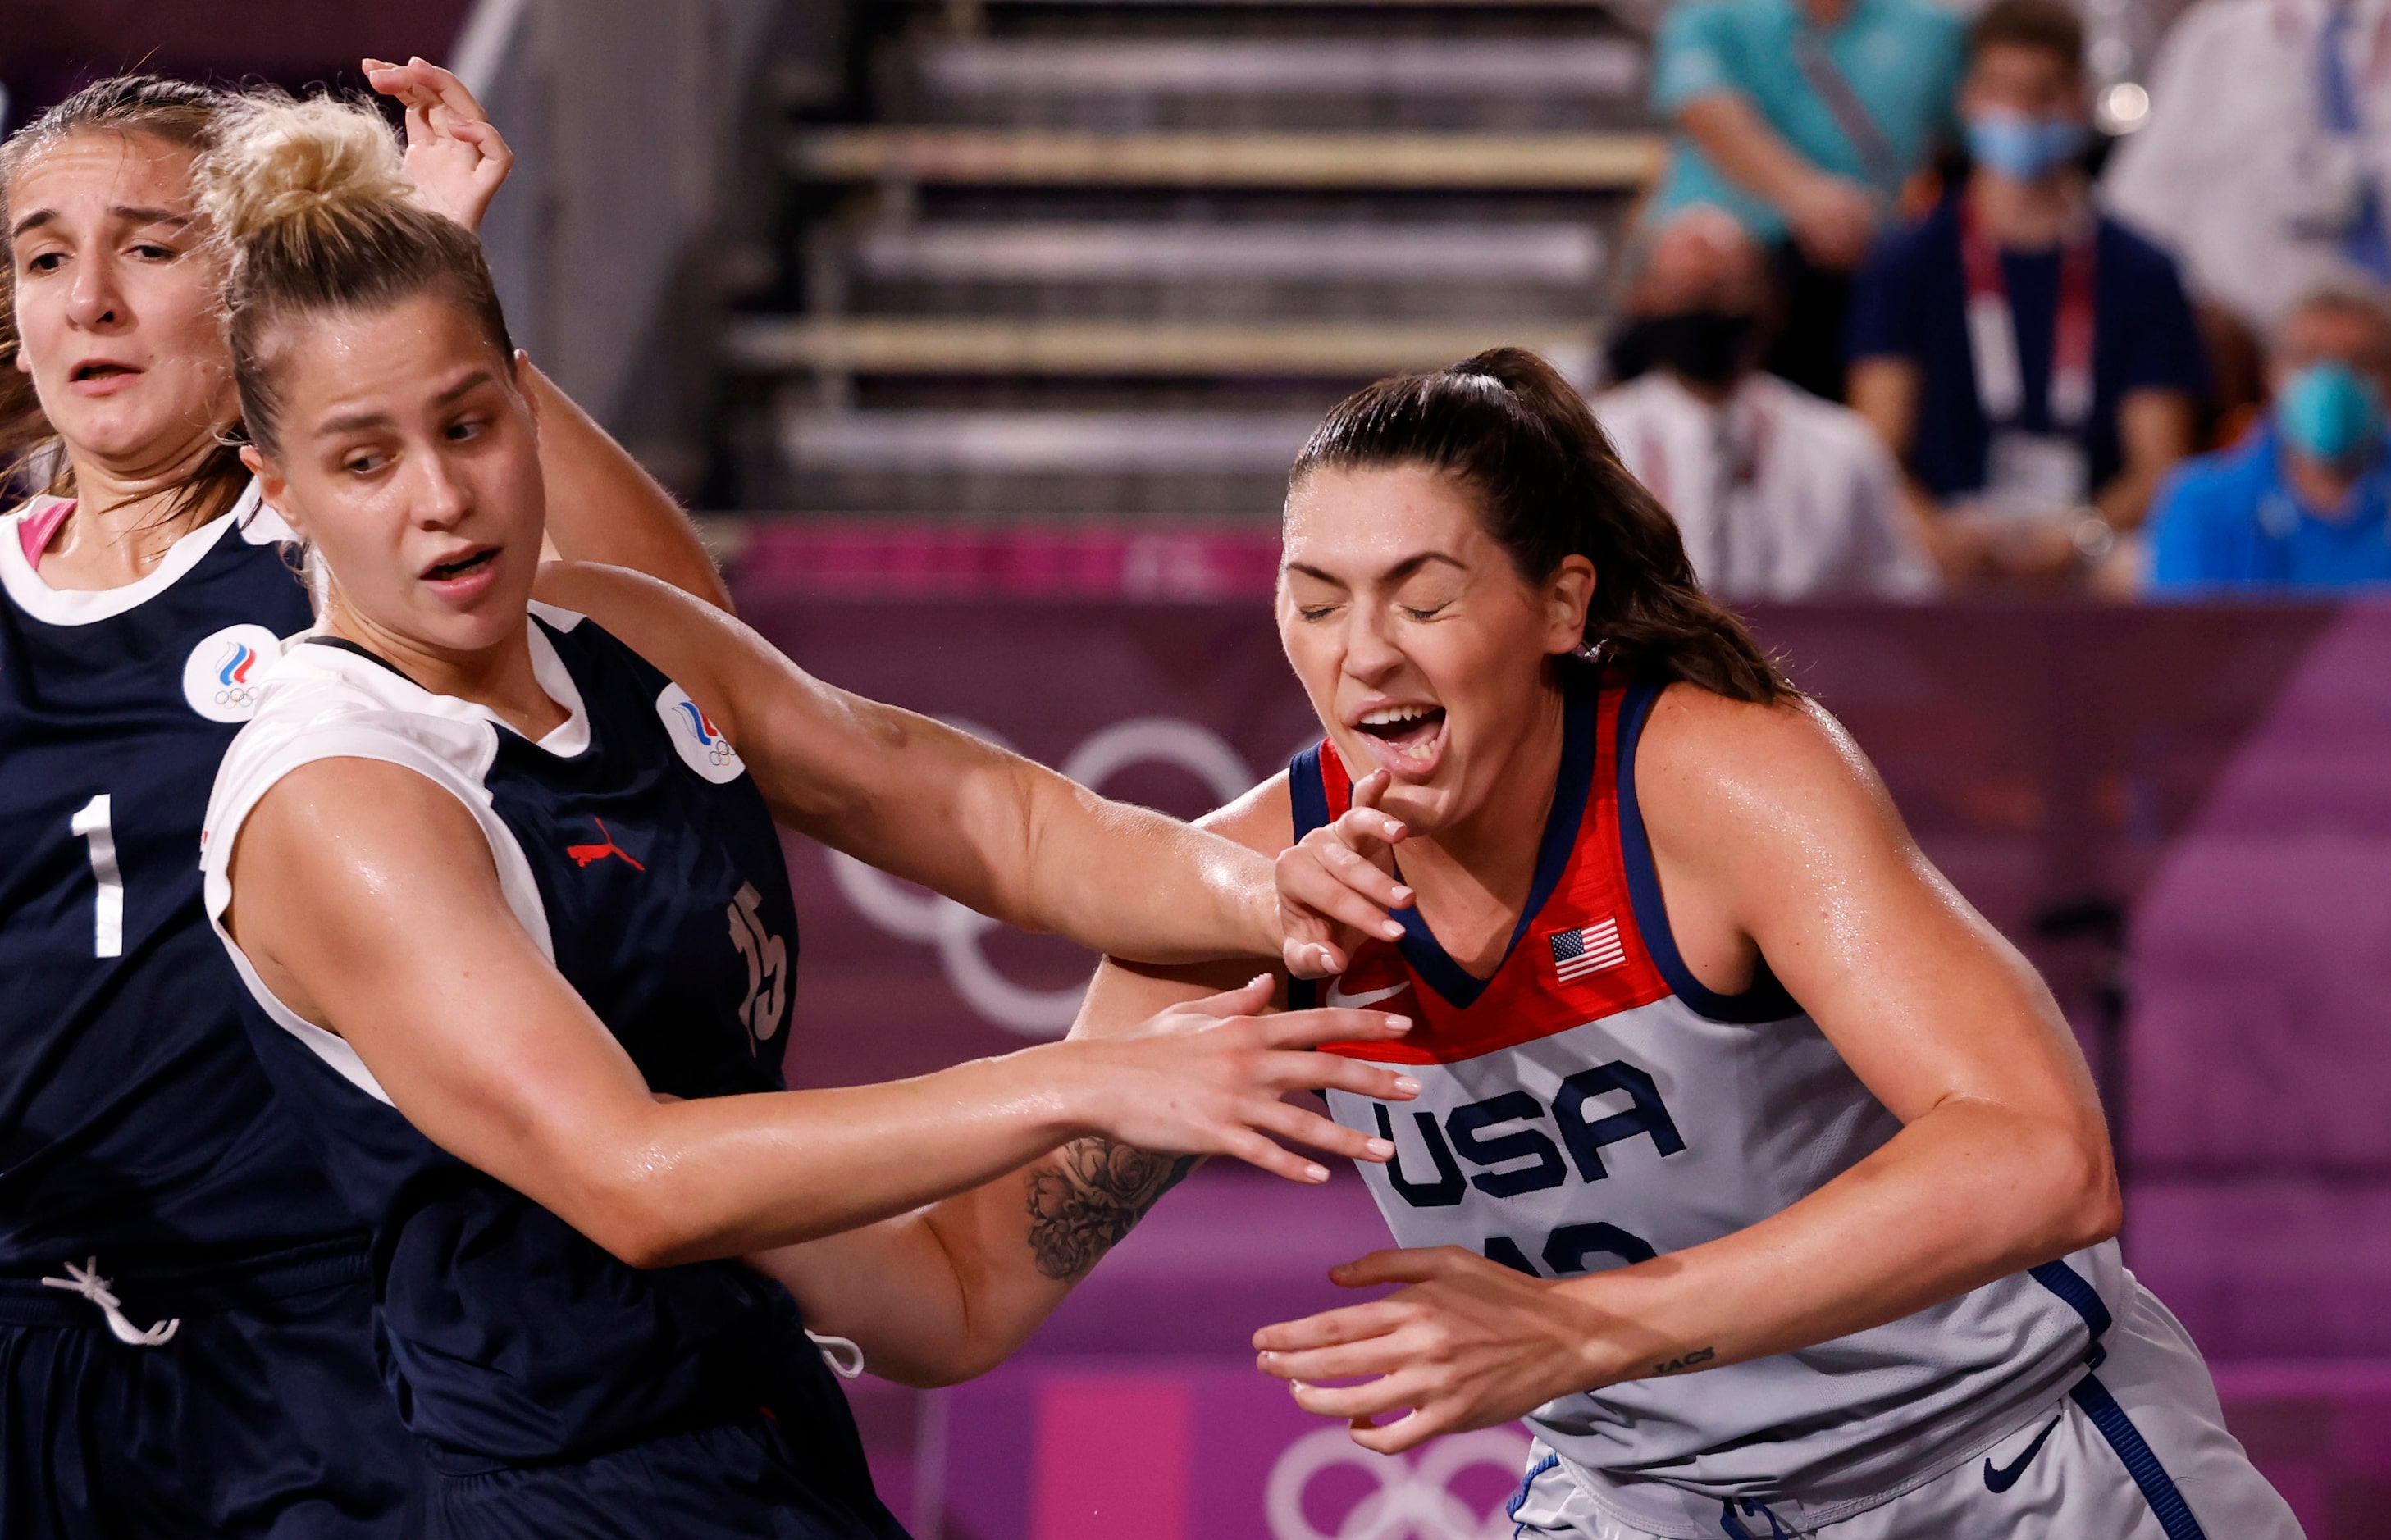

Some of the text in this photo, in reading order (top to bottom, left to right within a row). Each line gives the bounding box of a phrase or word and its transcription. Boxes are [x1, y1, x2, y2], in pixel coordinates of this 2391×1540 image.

[72, 793, 124, 958] 1
[727, 879, 787, 1058] 15
[1373, 1060, 1686, 1207] USA
